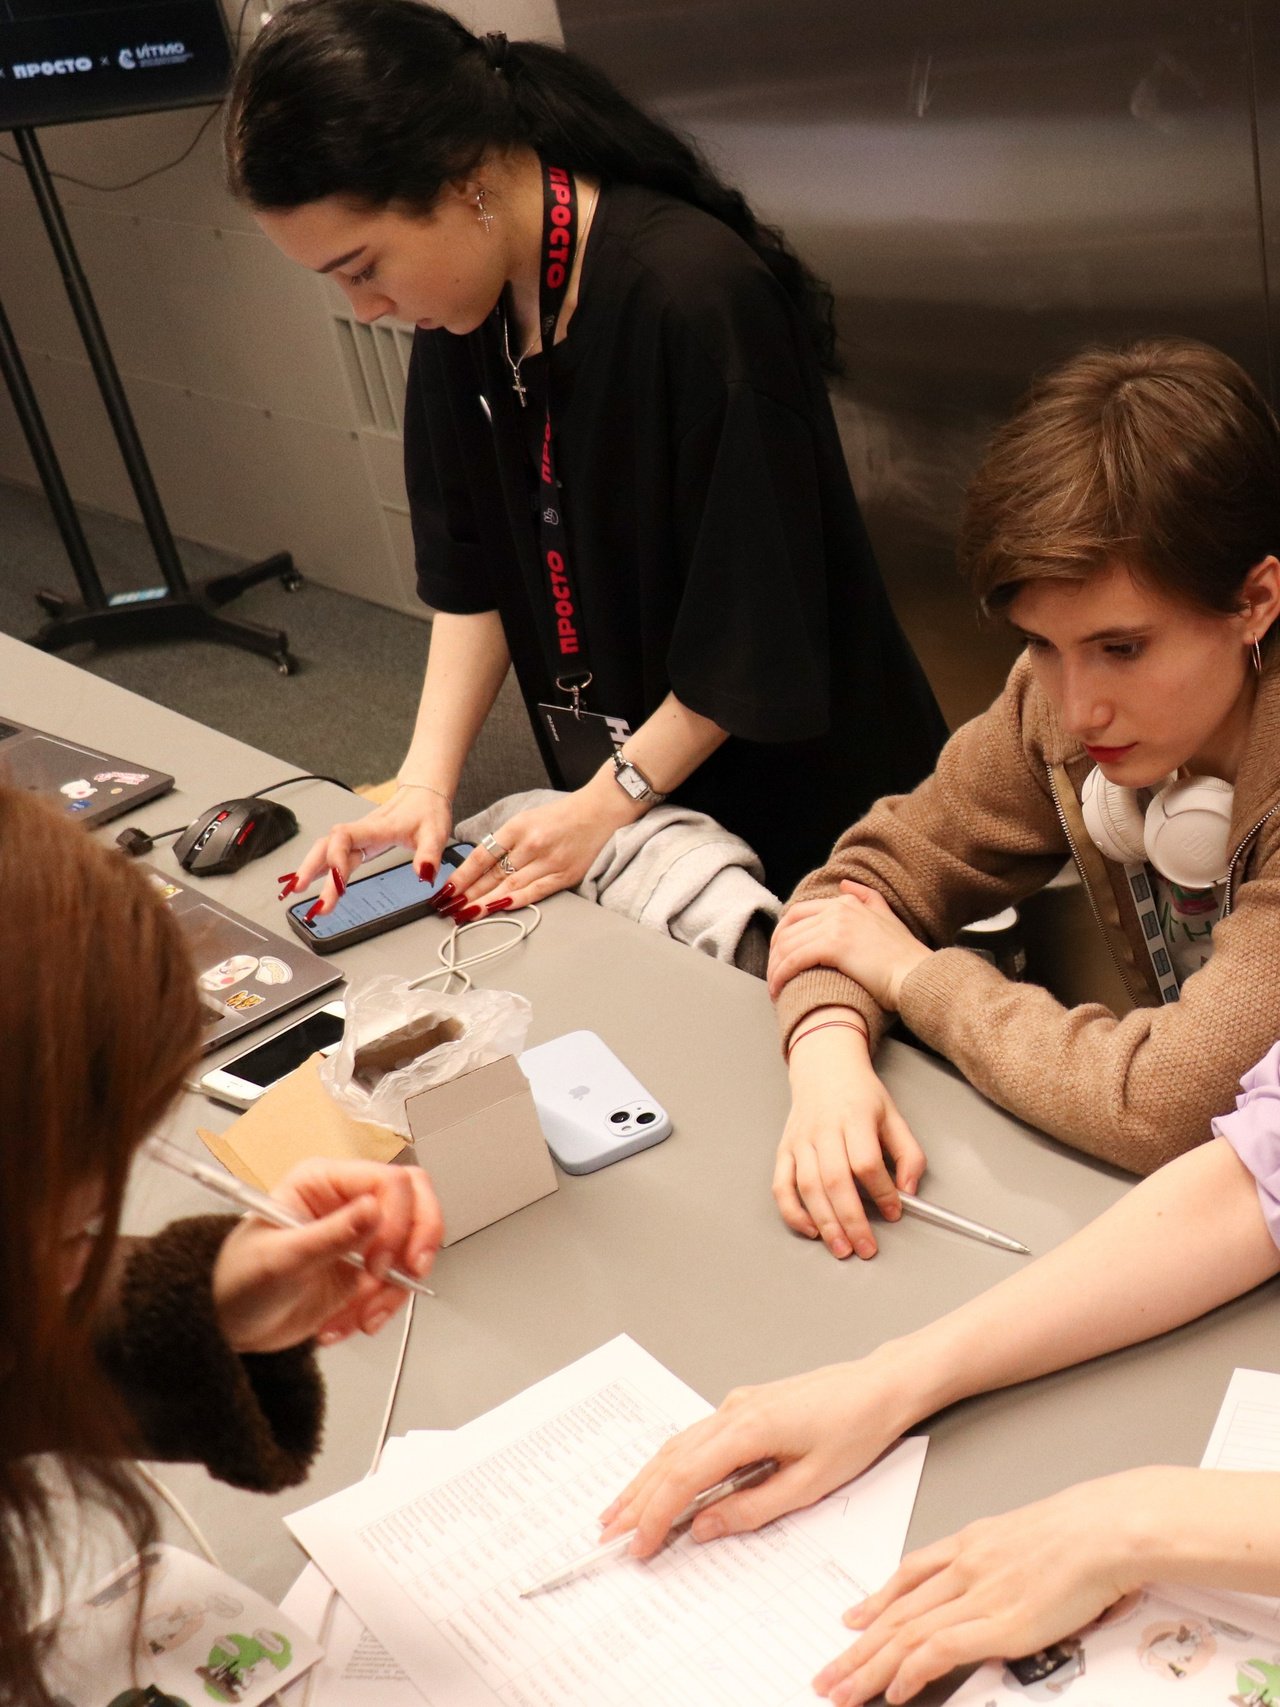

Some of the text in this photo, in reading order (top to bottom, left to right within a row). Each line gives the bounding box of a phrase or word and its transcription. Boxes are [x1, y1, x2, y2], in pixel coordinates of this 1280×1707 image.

[12, 57, 94, 80] ПРОСТО
[547, 165, 572, 289] ПРОСТО
[547, 550, 579, 654] ПРОСТО
